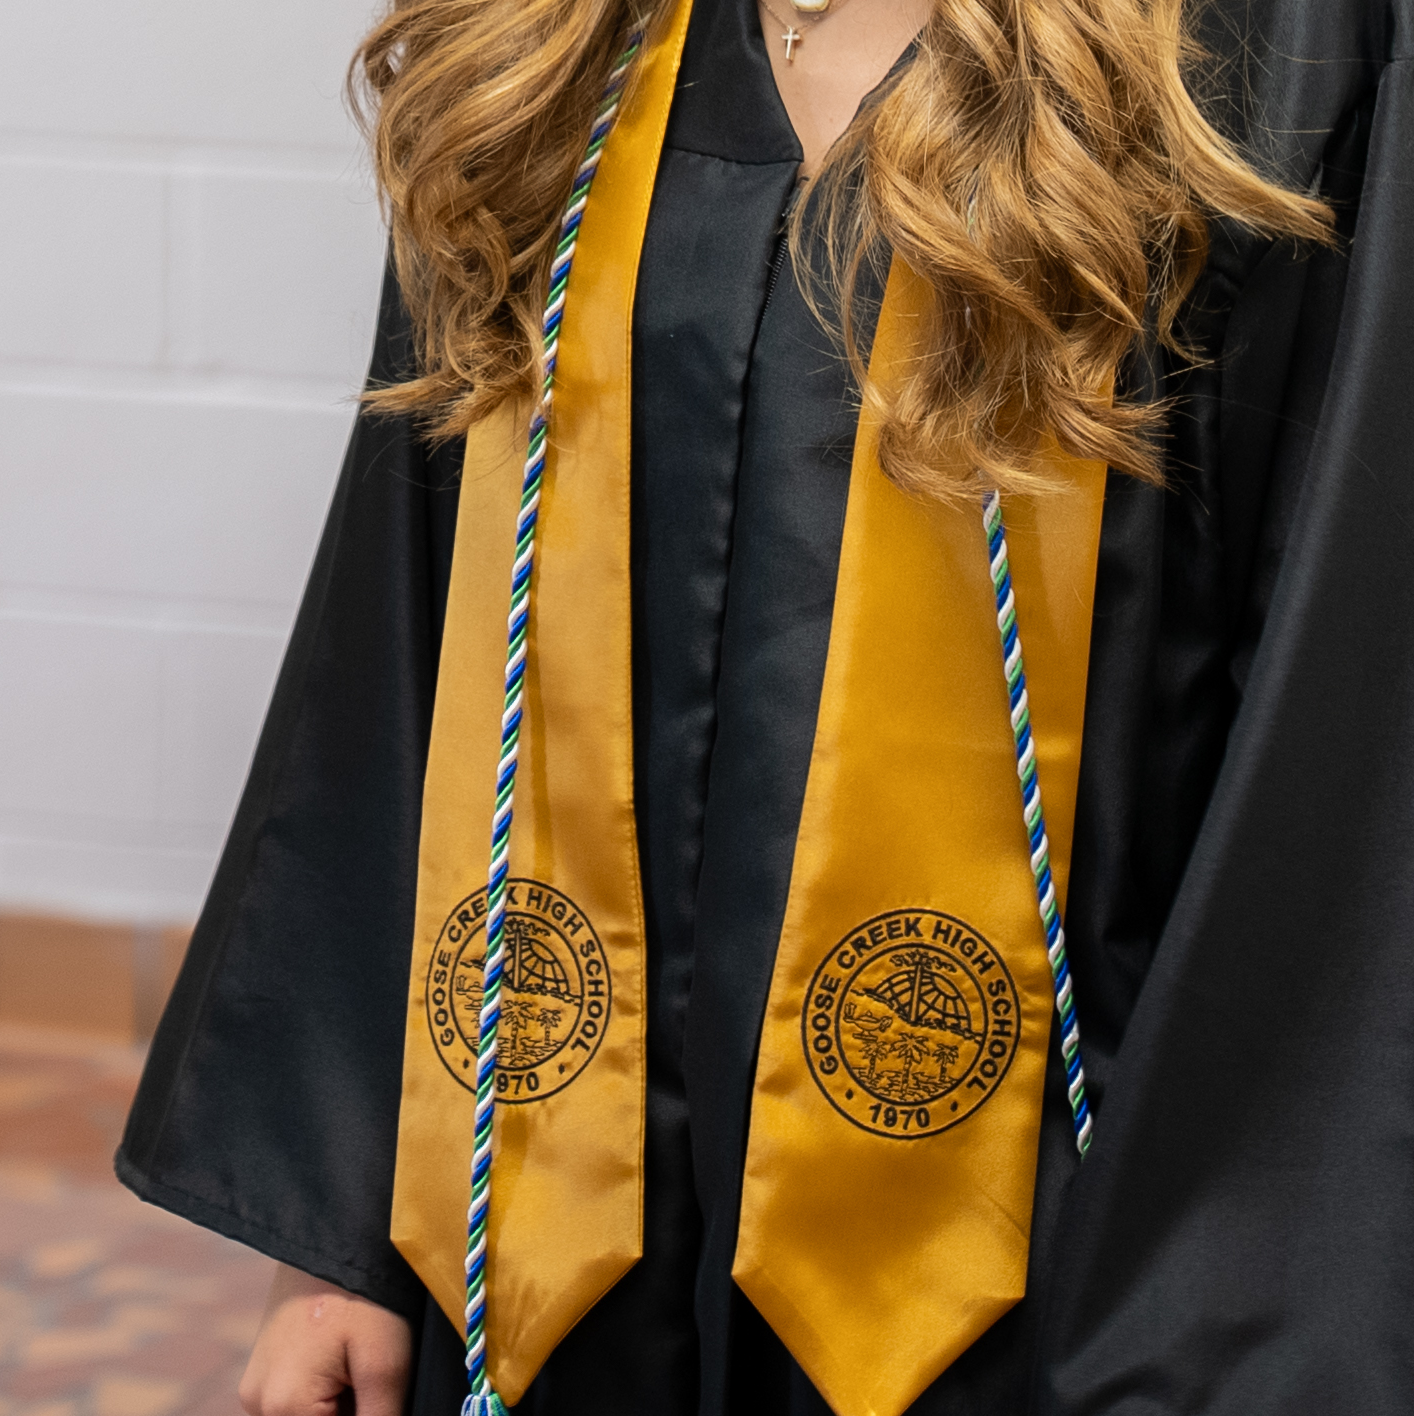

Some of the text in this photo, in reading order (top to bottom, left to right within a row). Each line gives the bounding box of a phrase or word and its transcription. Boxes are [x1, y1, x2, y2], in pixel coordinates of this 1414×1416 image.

[432, 886, 605, 1052] GOOSE CREK HIGH SCHOOL
[811, 916, 1013, 1091] GOOSE CREEK HIGH SCHOOL
[496, 1071, 540, 1095] 970
[868, 1102, 931, 1131] 1970
